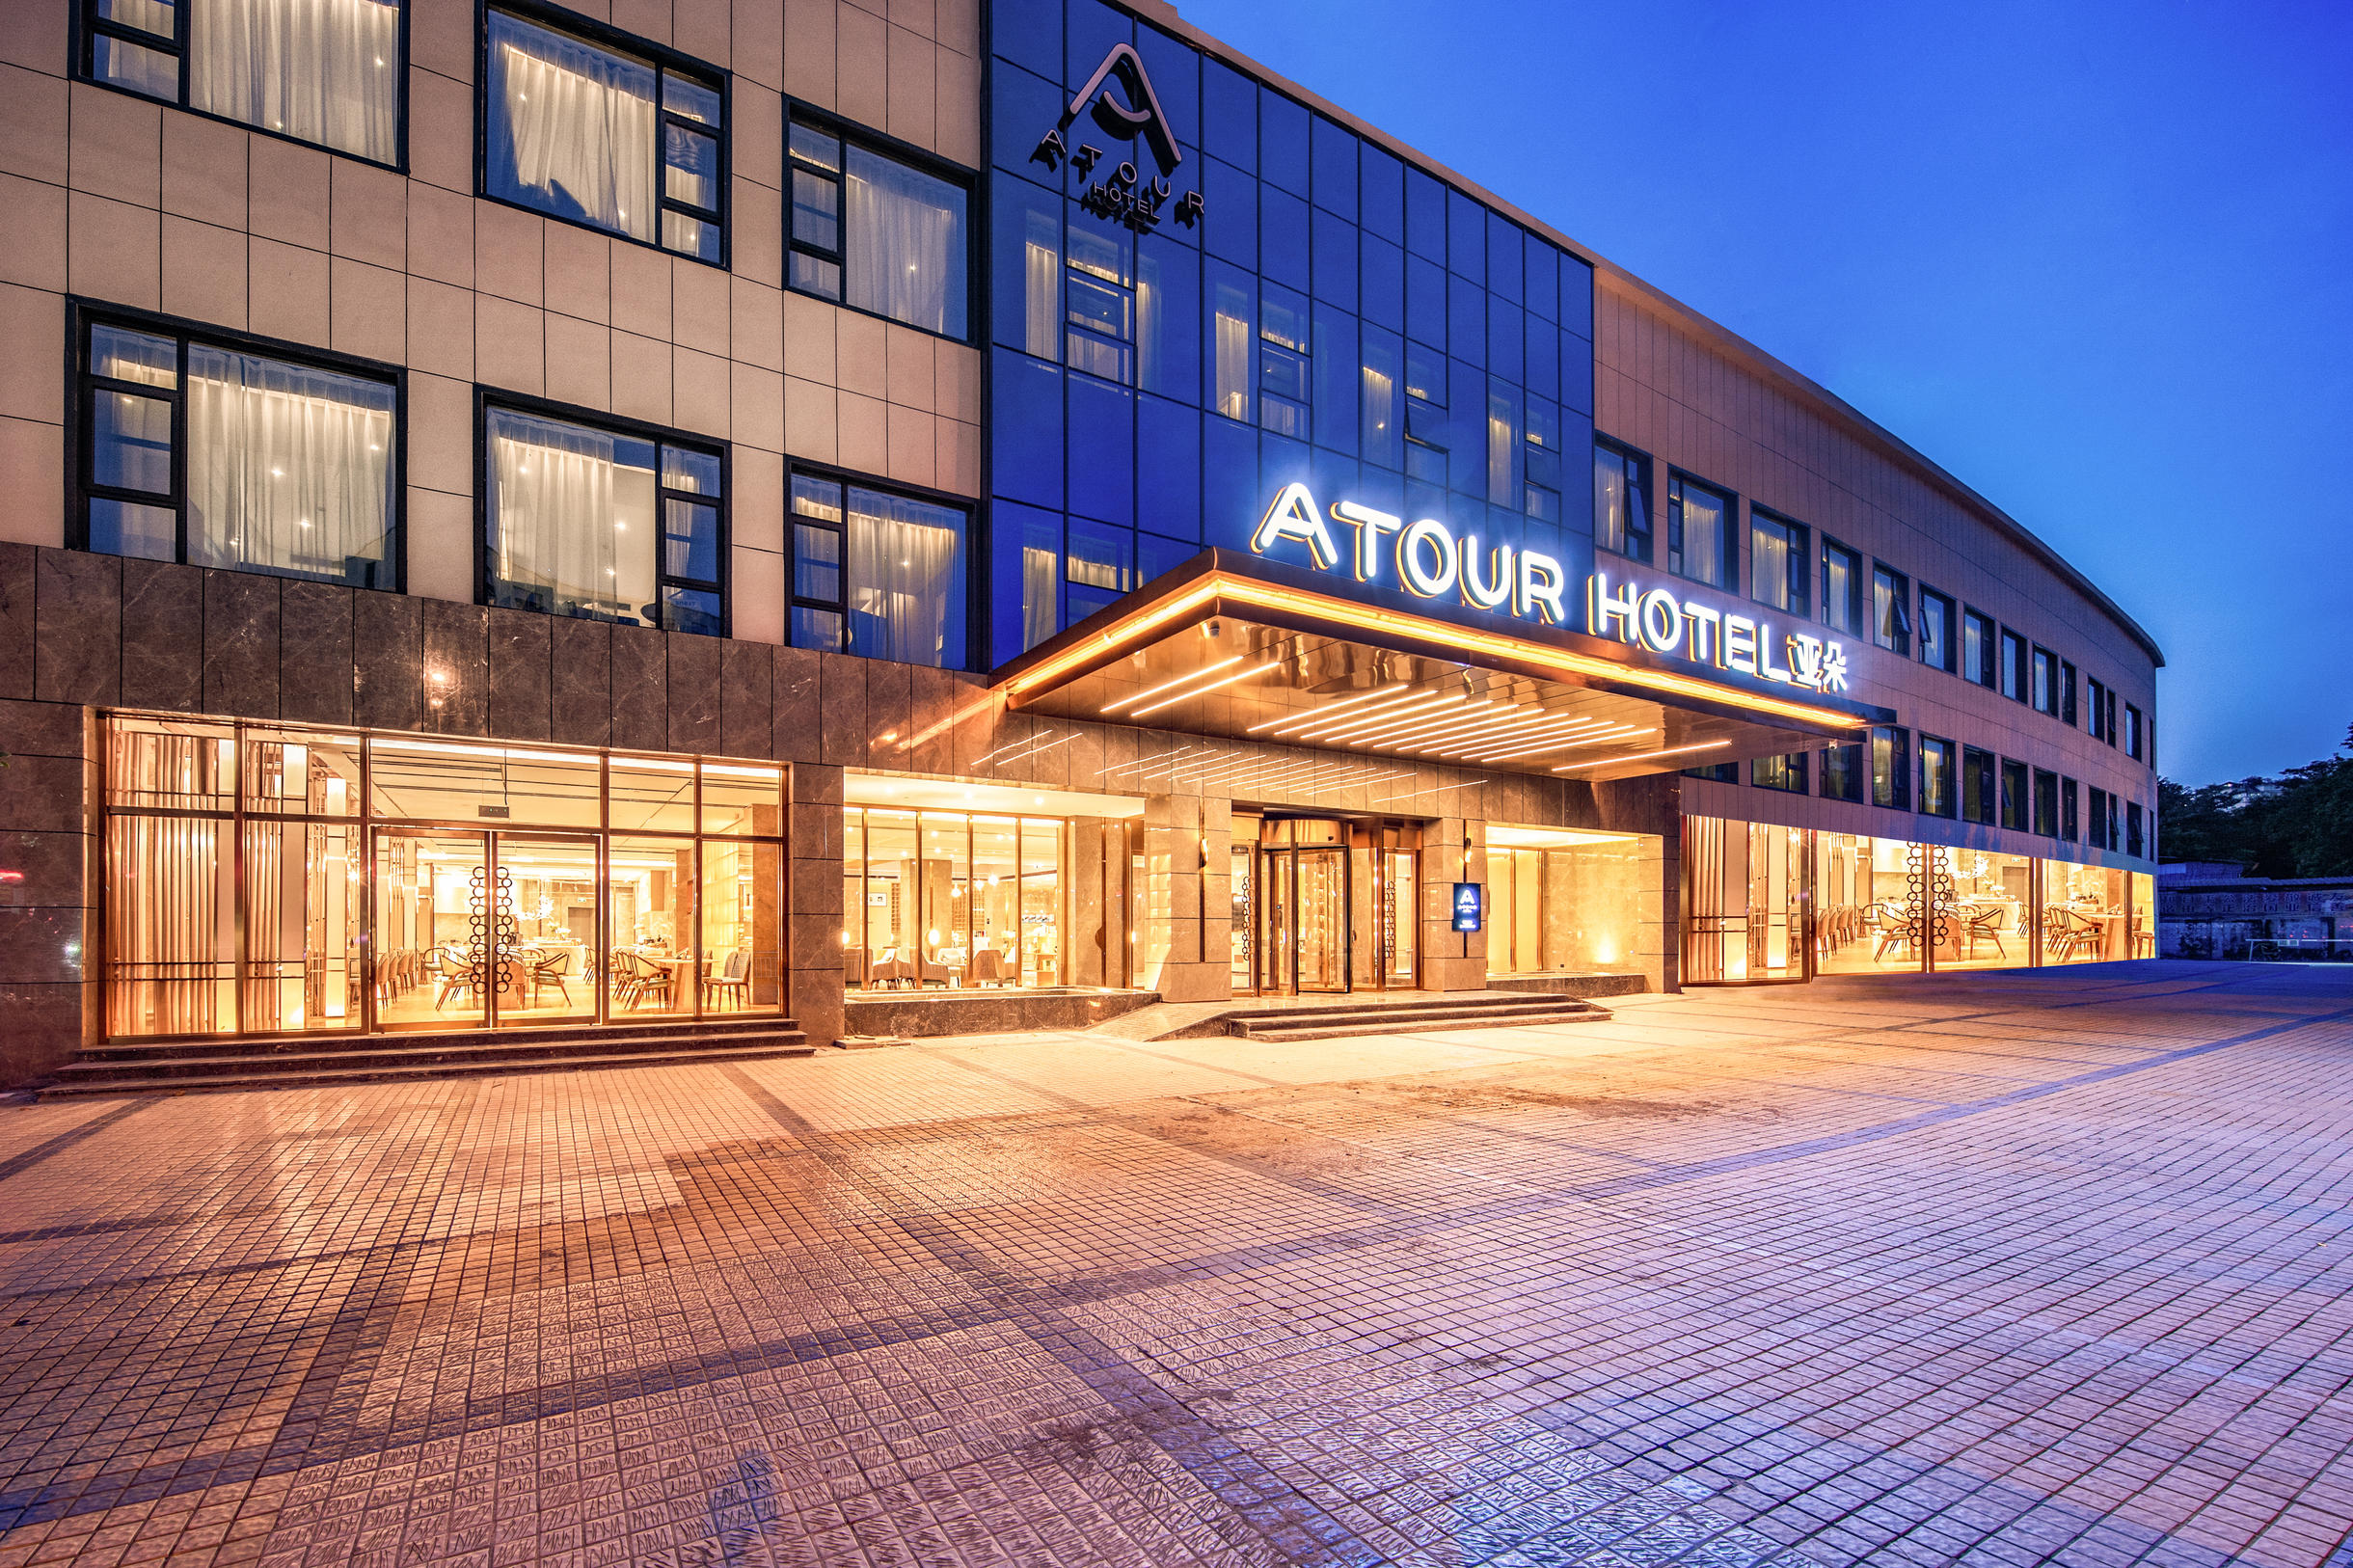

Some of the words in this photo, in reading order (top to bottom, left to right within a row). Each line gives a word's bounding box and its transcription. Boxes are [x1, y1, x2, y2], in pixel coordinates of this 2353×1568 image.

[1040, 128, 1205, 215] ATOUR
[1093, 180, 1161, 219] HOTEL
[1257, 481, 1565, 624] ATOUR
[1593, 572, 1791, 685] HOTEL
[1795, 633, 1849, 693] 亚朵
